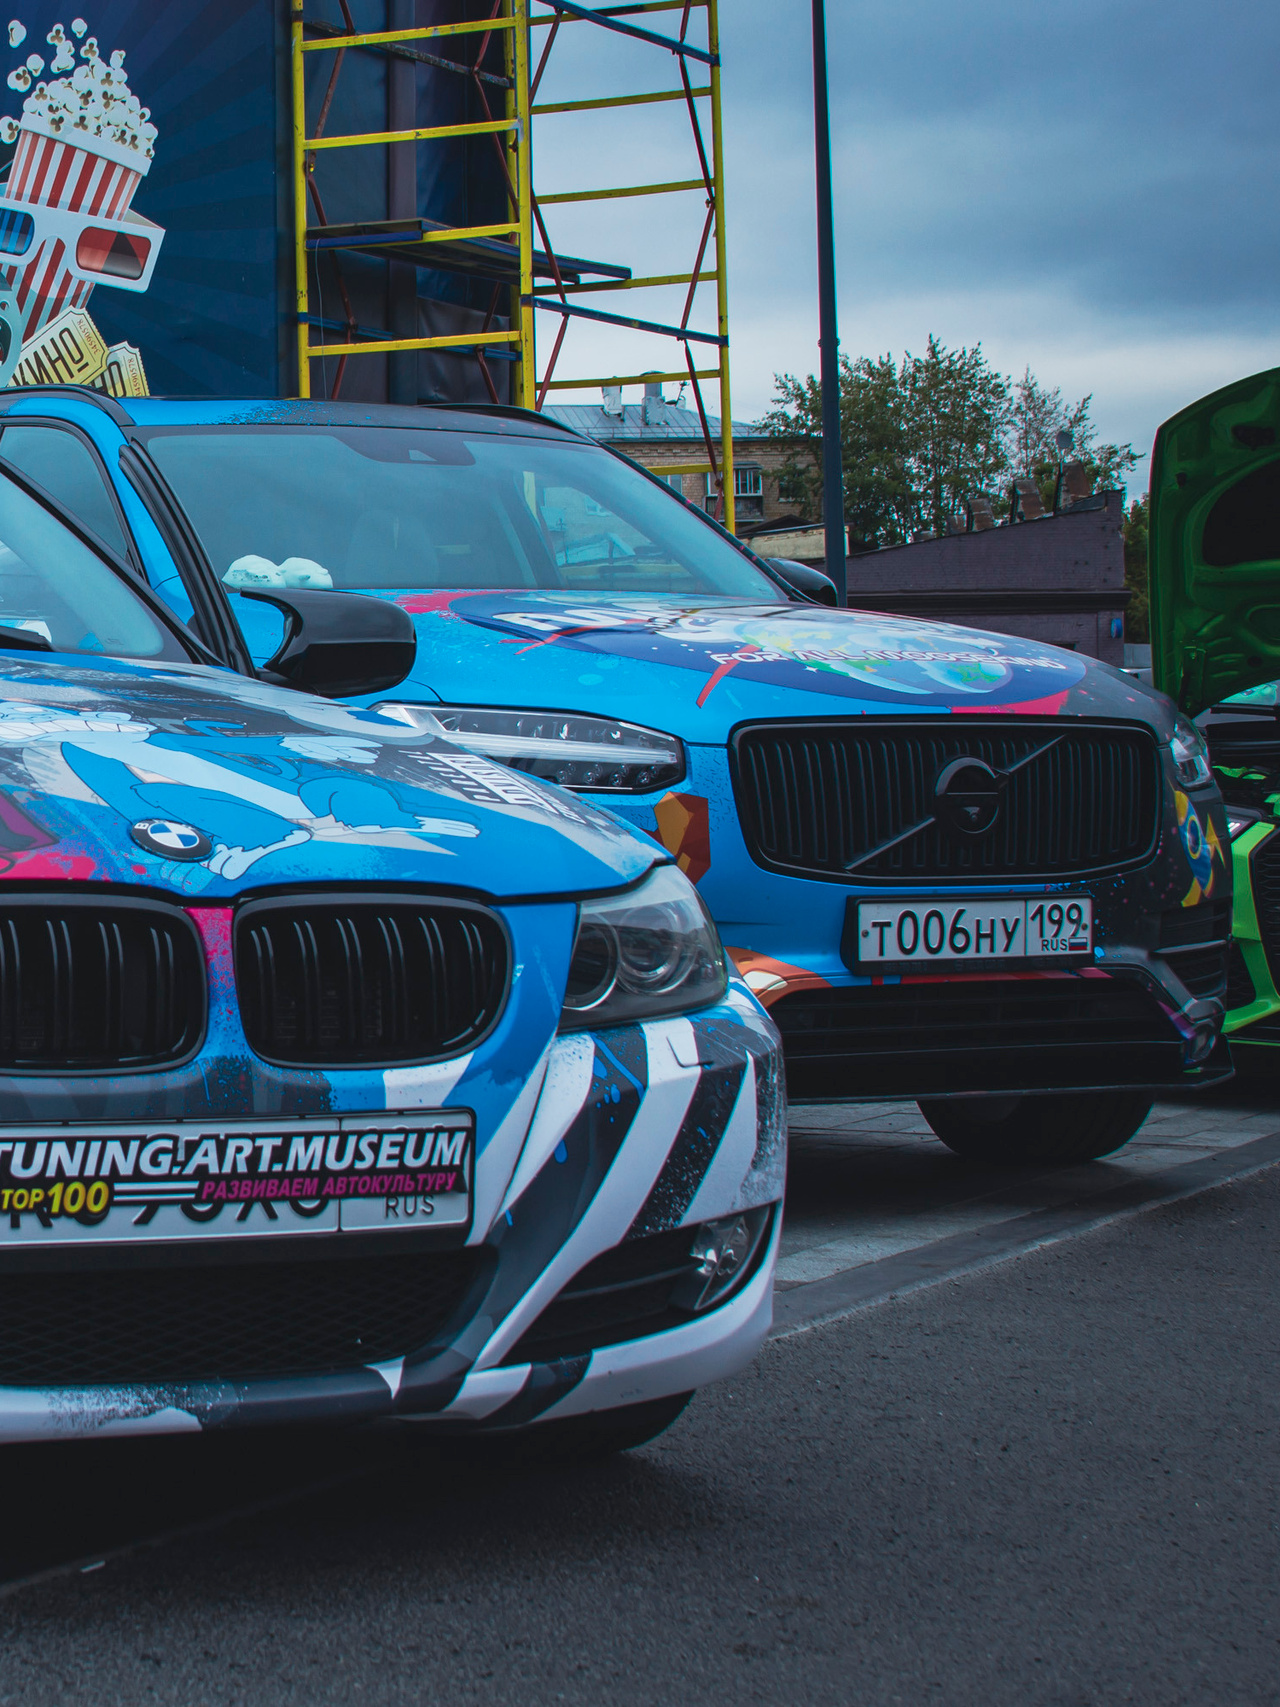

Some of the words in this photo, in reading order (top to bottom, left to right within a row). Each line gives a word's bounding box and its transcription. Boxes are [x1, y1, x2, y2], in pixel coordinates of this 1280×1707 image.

[709, 651, 789, 665] FOR
[792, 650, 867, 661] ALL
[1029, 902, 1082, 939] 199
[1041, 939, 1069, 951] RUS
[201, 1177, 319, 1200] РАЗВИВАЕМ
[322, 1172, 457, 1196] АВТОКУЛЬТУРУ
[385, 1195, 434, 1219] RUS
